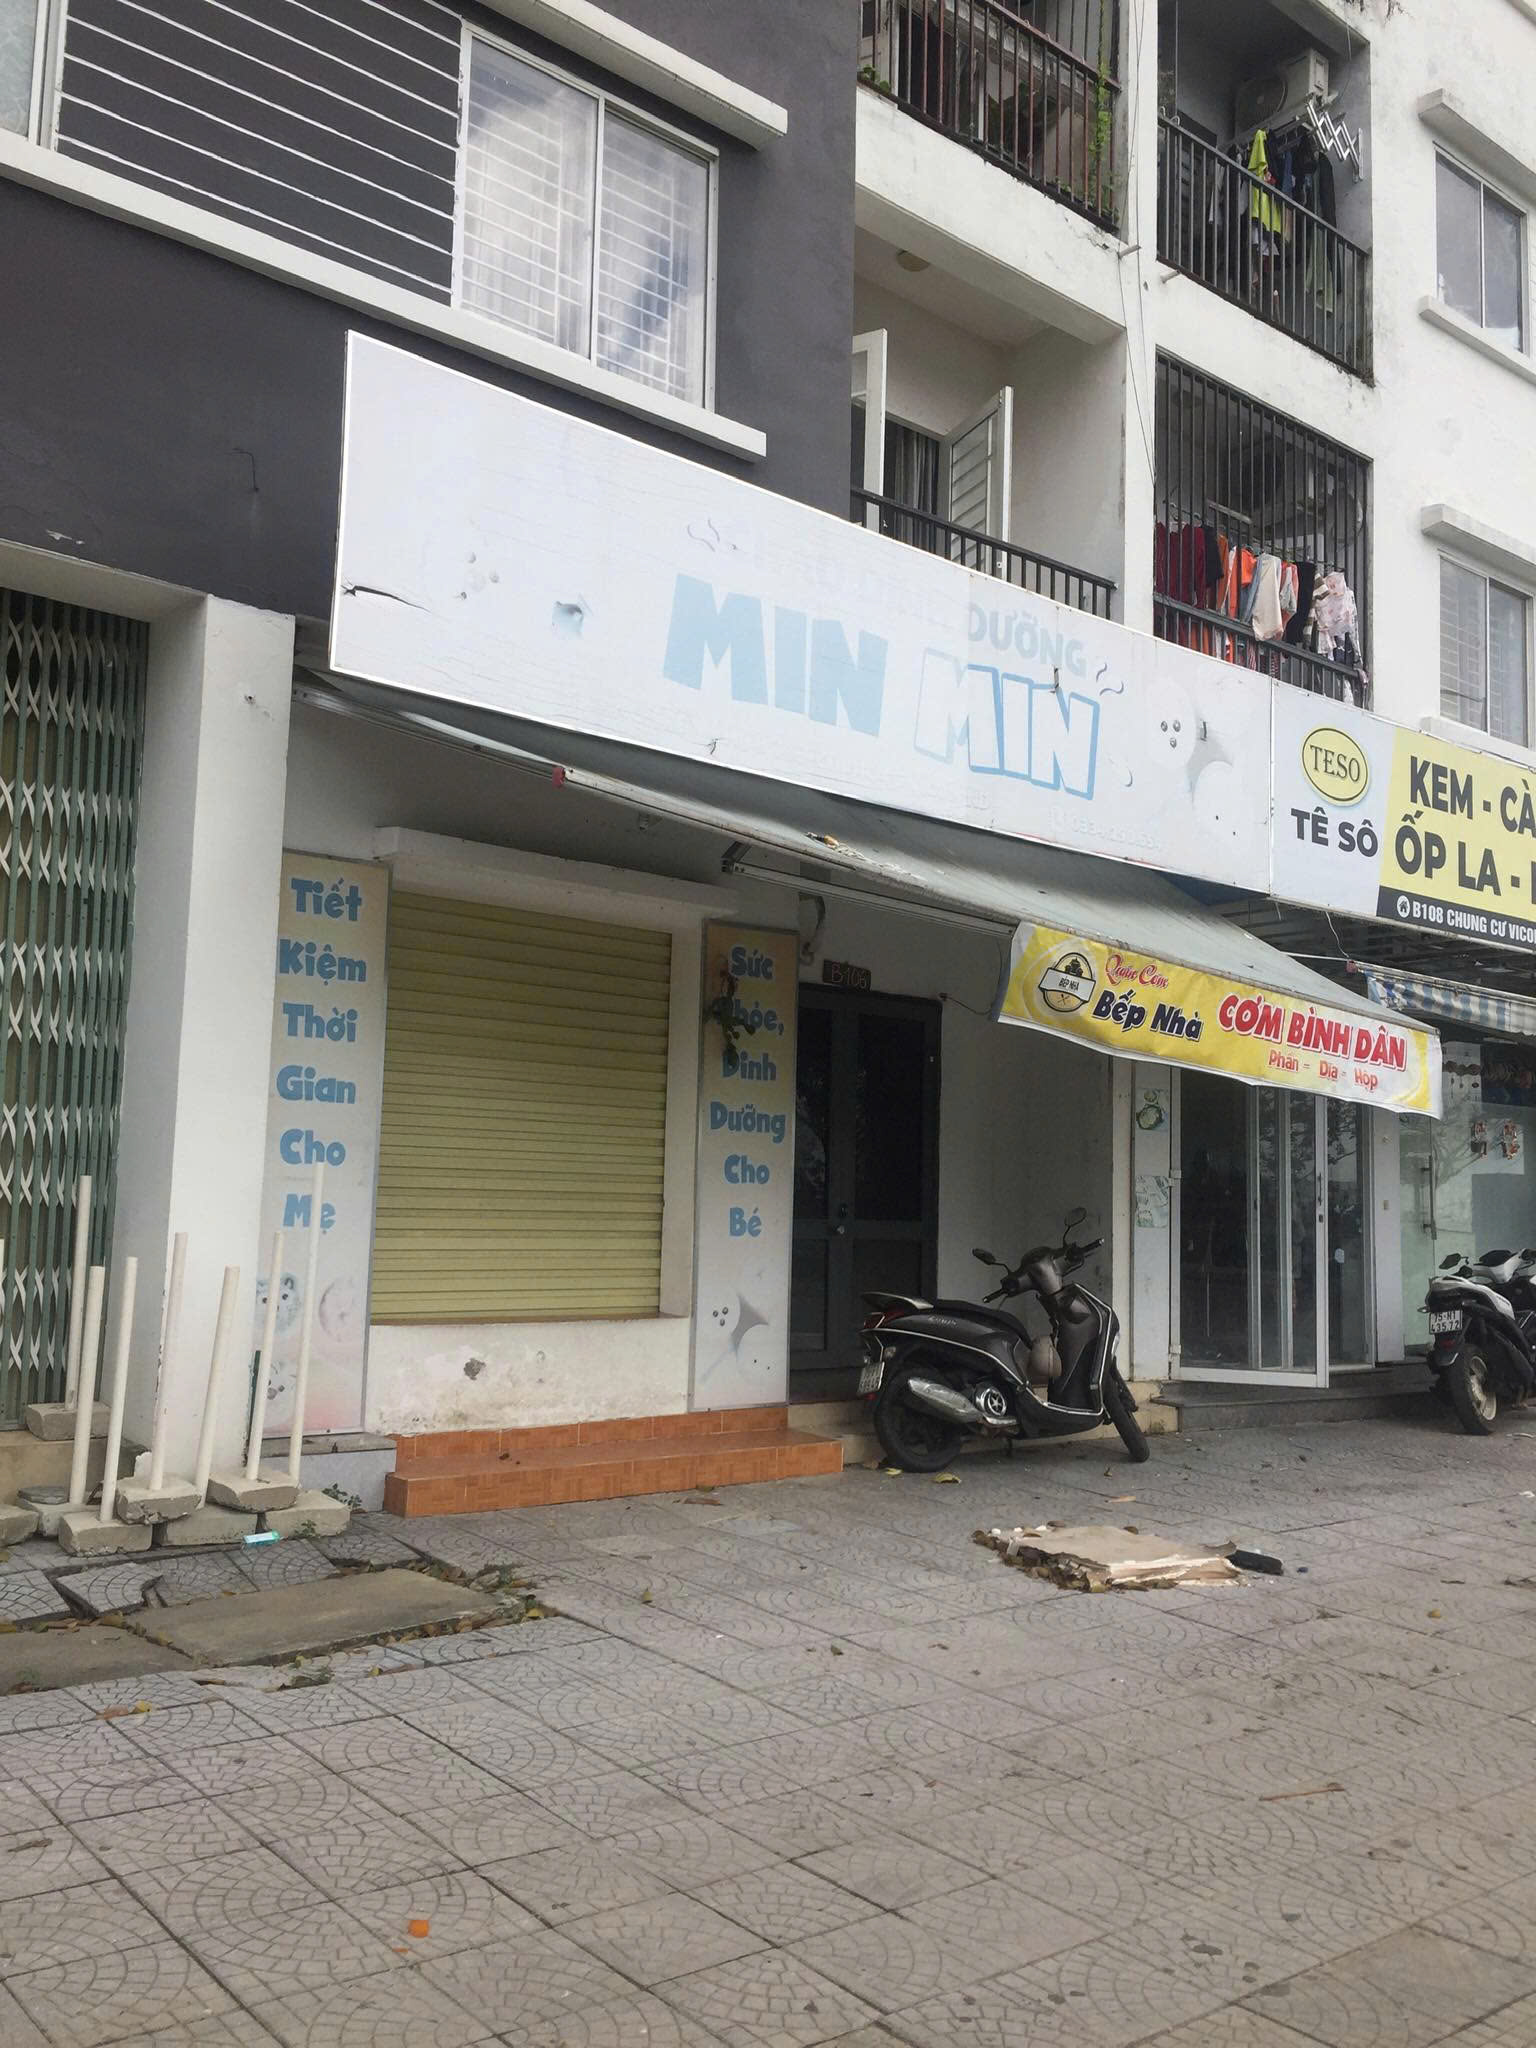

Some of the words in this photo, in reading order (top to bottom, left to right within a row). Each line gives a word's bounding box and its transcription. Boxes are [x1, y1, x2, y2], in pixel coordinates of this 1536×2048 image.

[663, 573, 888, 737] MIN
[914, 646, 1100, 800] MIN
[1309, 743, 1361, 784] TESO
[1410, 755, 1473, 820] KEM
[1291, 807, 1329, 847] TÊ
[1338, 819, 1379, 858] SÔ
[1395, 809, 1447, 879] ỐP
[1458, 841, 1502, 896] LA
[291, 877, 362, 922] Tiết
[1412, 904, 1443, 924] B108
[1446, 909, 1488, 934] CHUNG
[1490, 918, 1507, 938] CƯ
[279, 939, 367, 986] Kiệm
[729, 944, 774, 980] Sức
[283, 1002, 358, 1042] Thời
[1092, 989, 1146, 1031] Bếp
[1151, 1003, 1203, 1041] Nhà
[1218, 993, 1282, 1043] CƠM
[1287, 1007, 1350, 1058] BÌNH
[1354, 1024, 1407, 1071] DÂN
[276, 1064, 356, 1105] Gian
[722, 1049, 777, 1081] Dinh
[710, 1101, 786, 1144] Dưỡng
[279, 1128, 346, 1168] Cho
[723, 1154, 770, 1185] Cho
[283, 1193, 336, 1235] Mẹ
[728, 1207, 763, 1238] Bé
